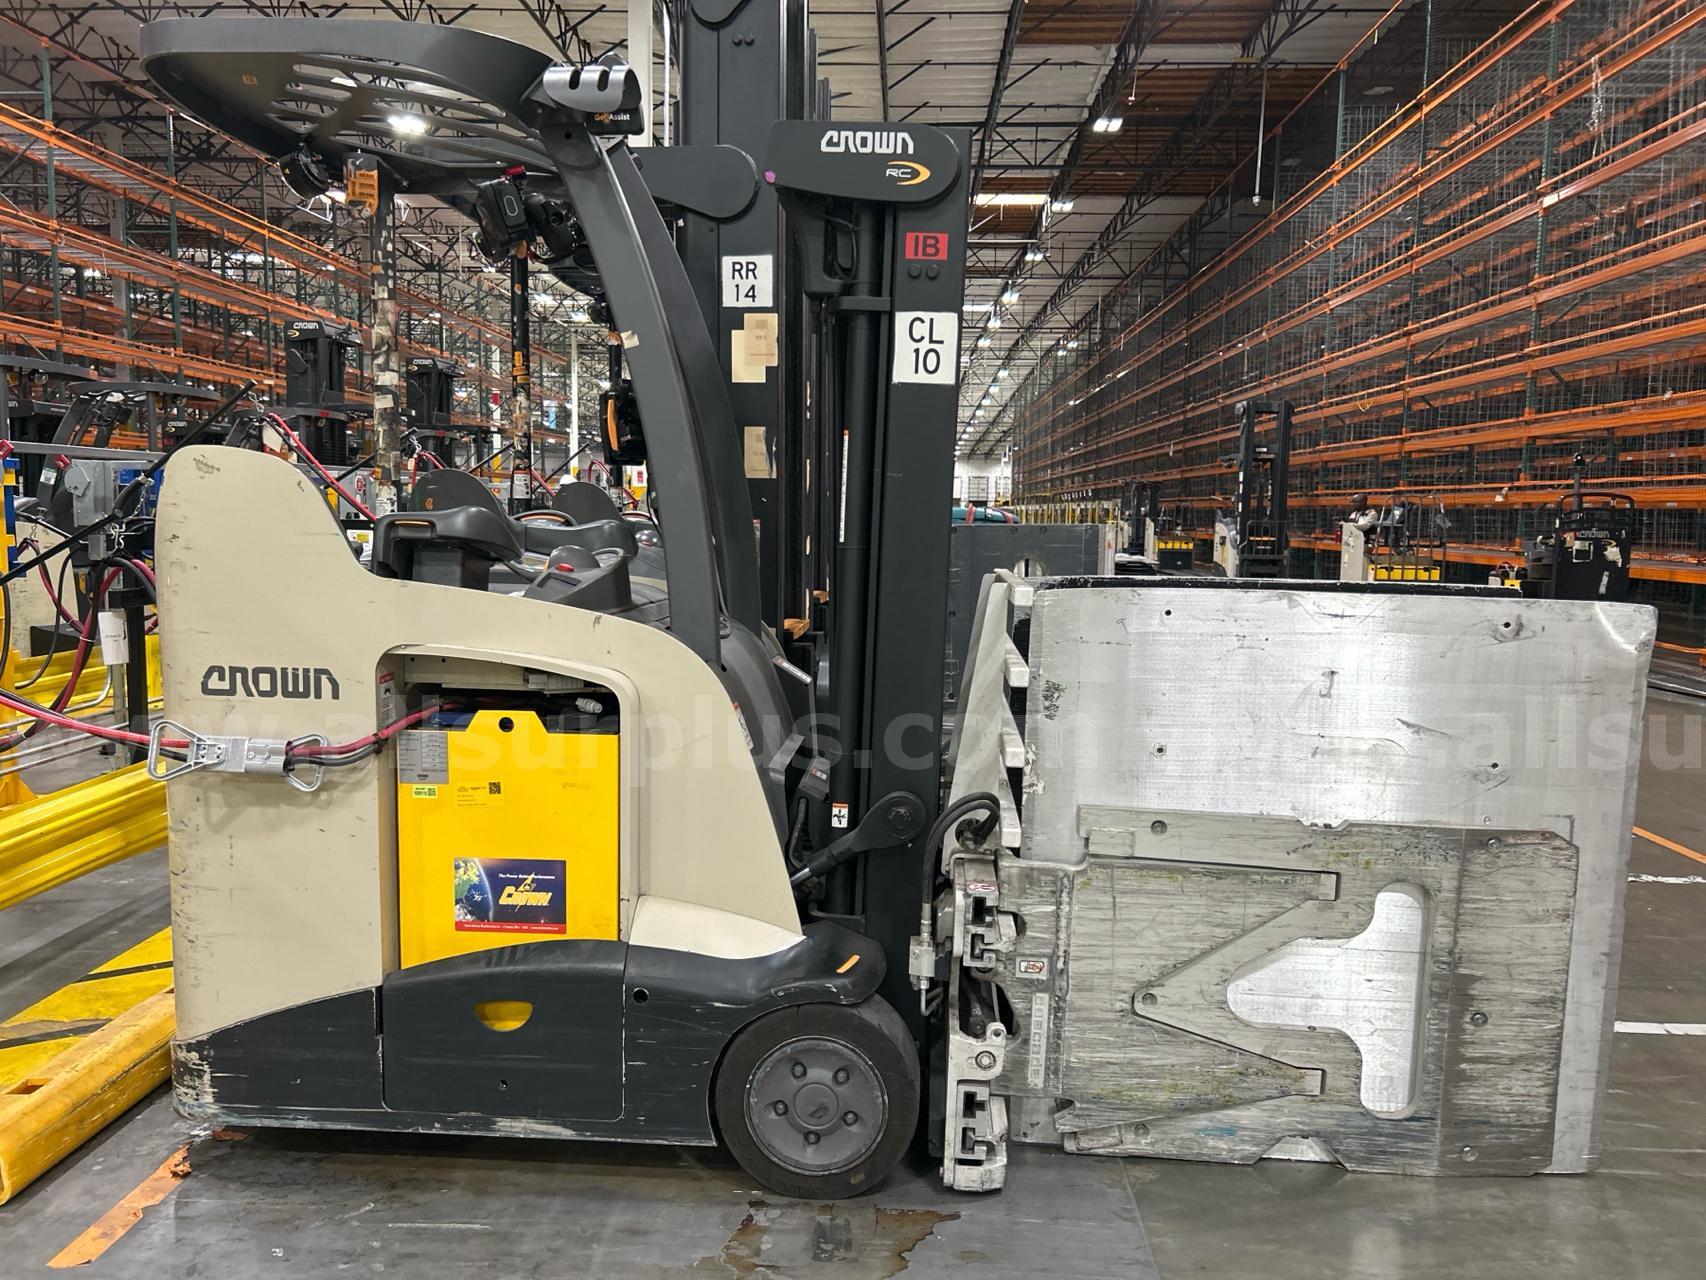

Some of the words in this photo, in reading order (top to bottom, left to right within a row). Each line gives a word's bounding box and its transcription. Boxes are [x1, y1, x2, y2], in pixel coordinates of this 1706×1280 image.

[820, 130, 914, 154] CROWN
[886, 168, 912, 178] RC
[731, 261, 757, 280] RR
[734, 283, 757, 303] 14
[293, 322, 319, 330] CROWN
[908, 316, 944, 345] CL
[912, 348, 941, 375] 10
[201, 665, 340, 700] CROWN
